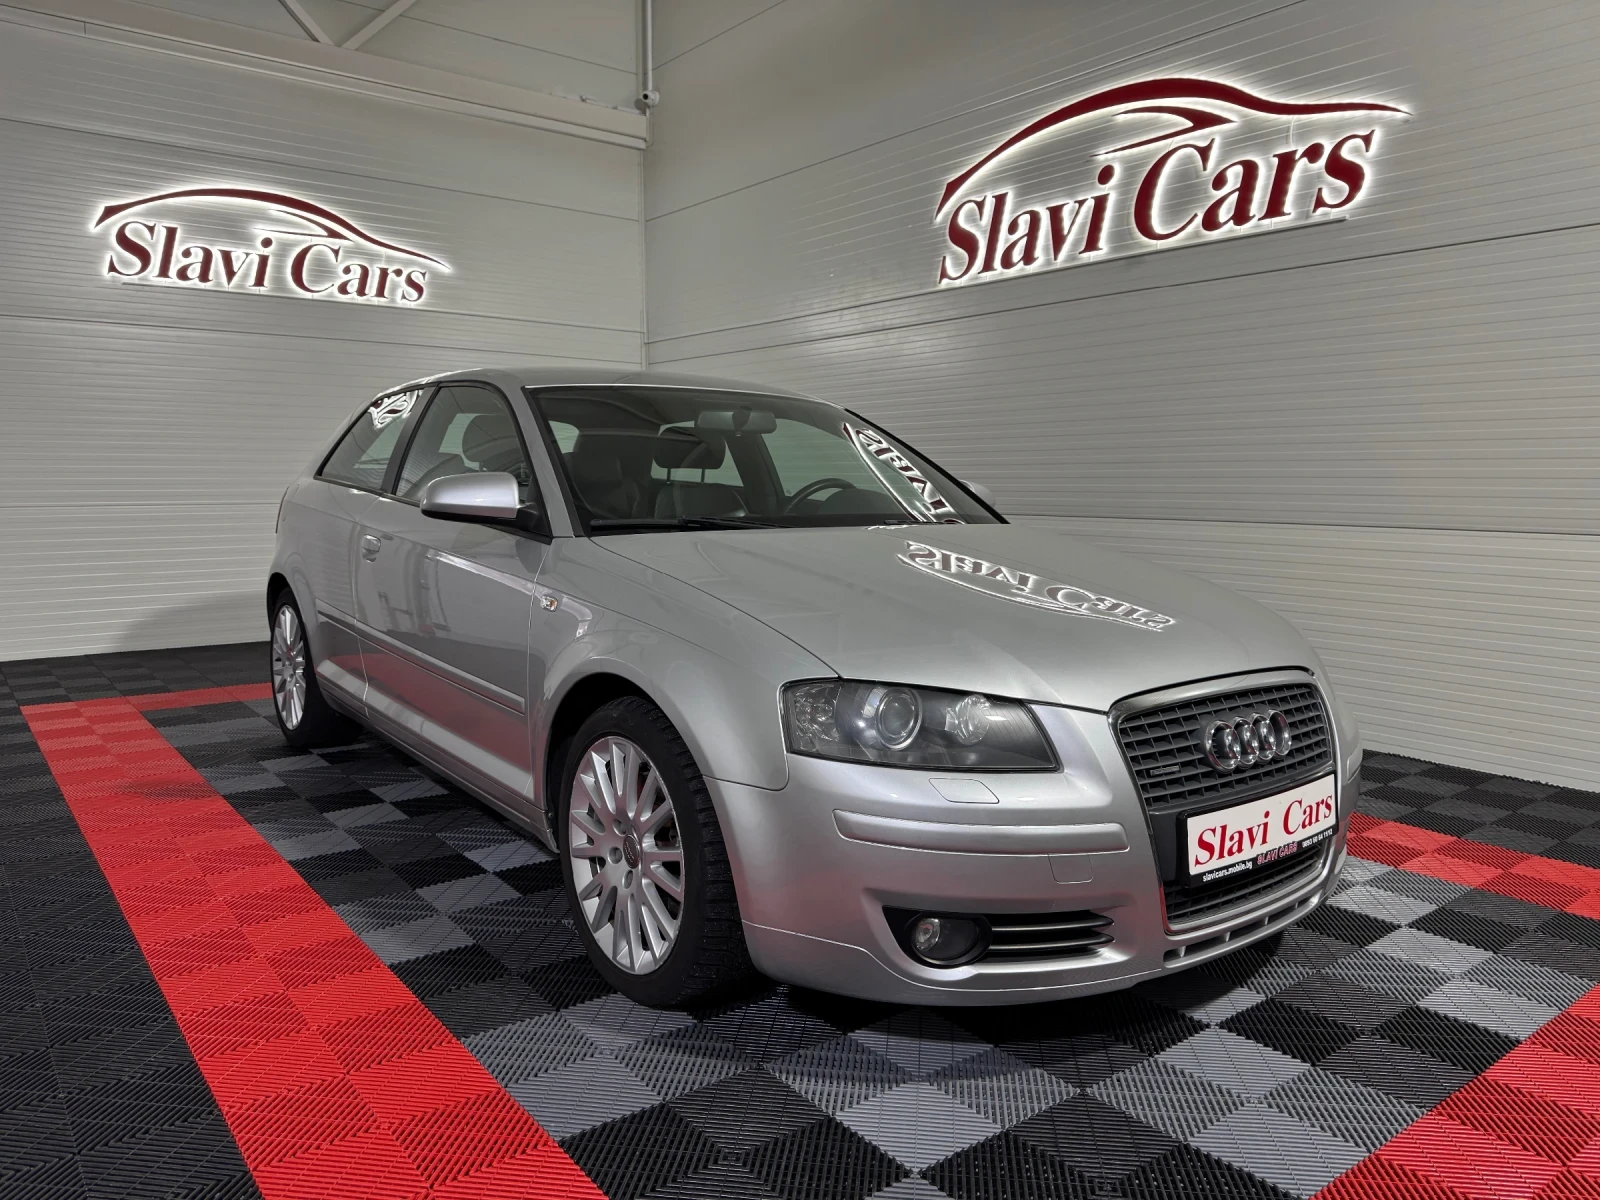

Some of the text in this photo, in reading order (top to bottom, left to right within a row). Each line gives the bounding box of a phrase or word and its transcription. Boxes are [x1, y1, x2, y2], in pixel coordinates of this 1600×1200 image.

[938, 128, 1378, 285] Slavi Cars
[106, 221, 428, 302] Slavi Cars
[1195, 795, 1333, 867] Slavi Cars
[1257, 841, 1298, 865] SLAVI CARS
[1203, 860, 1253, 882] slavicars.mobile.bg
